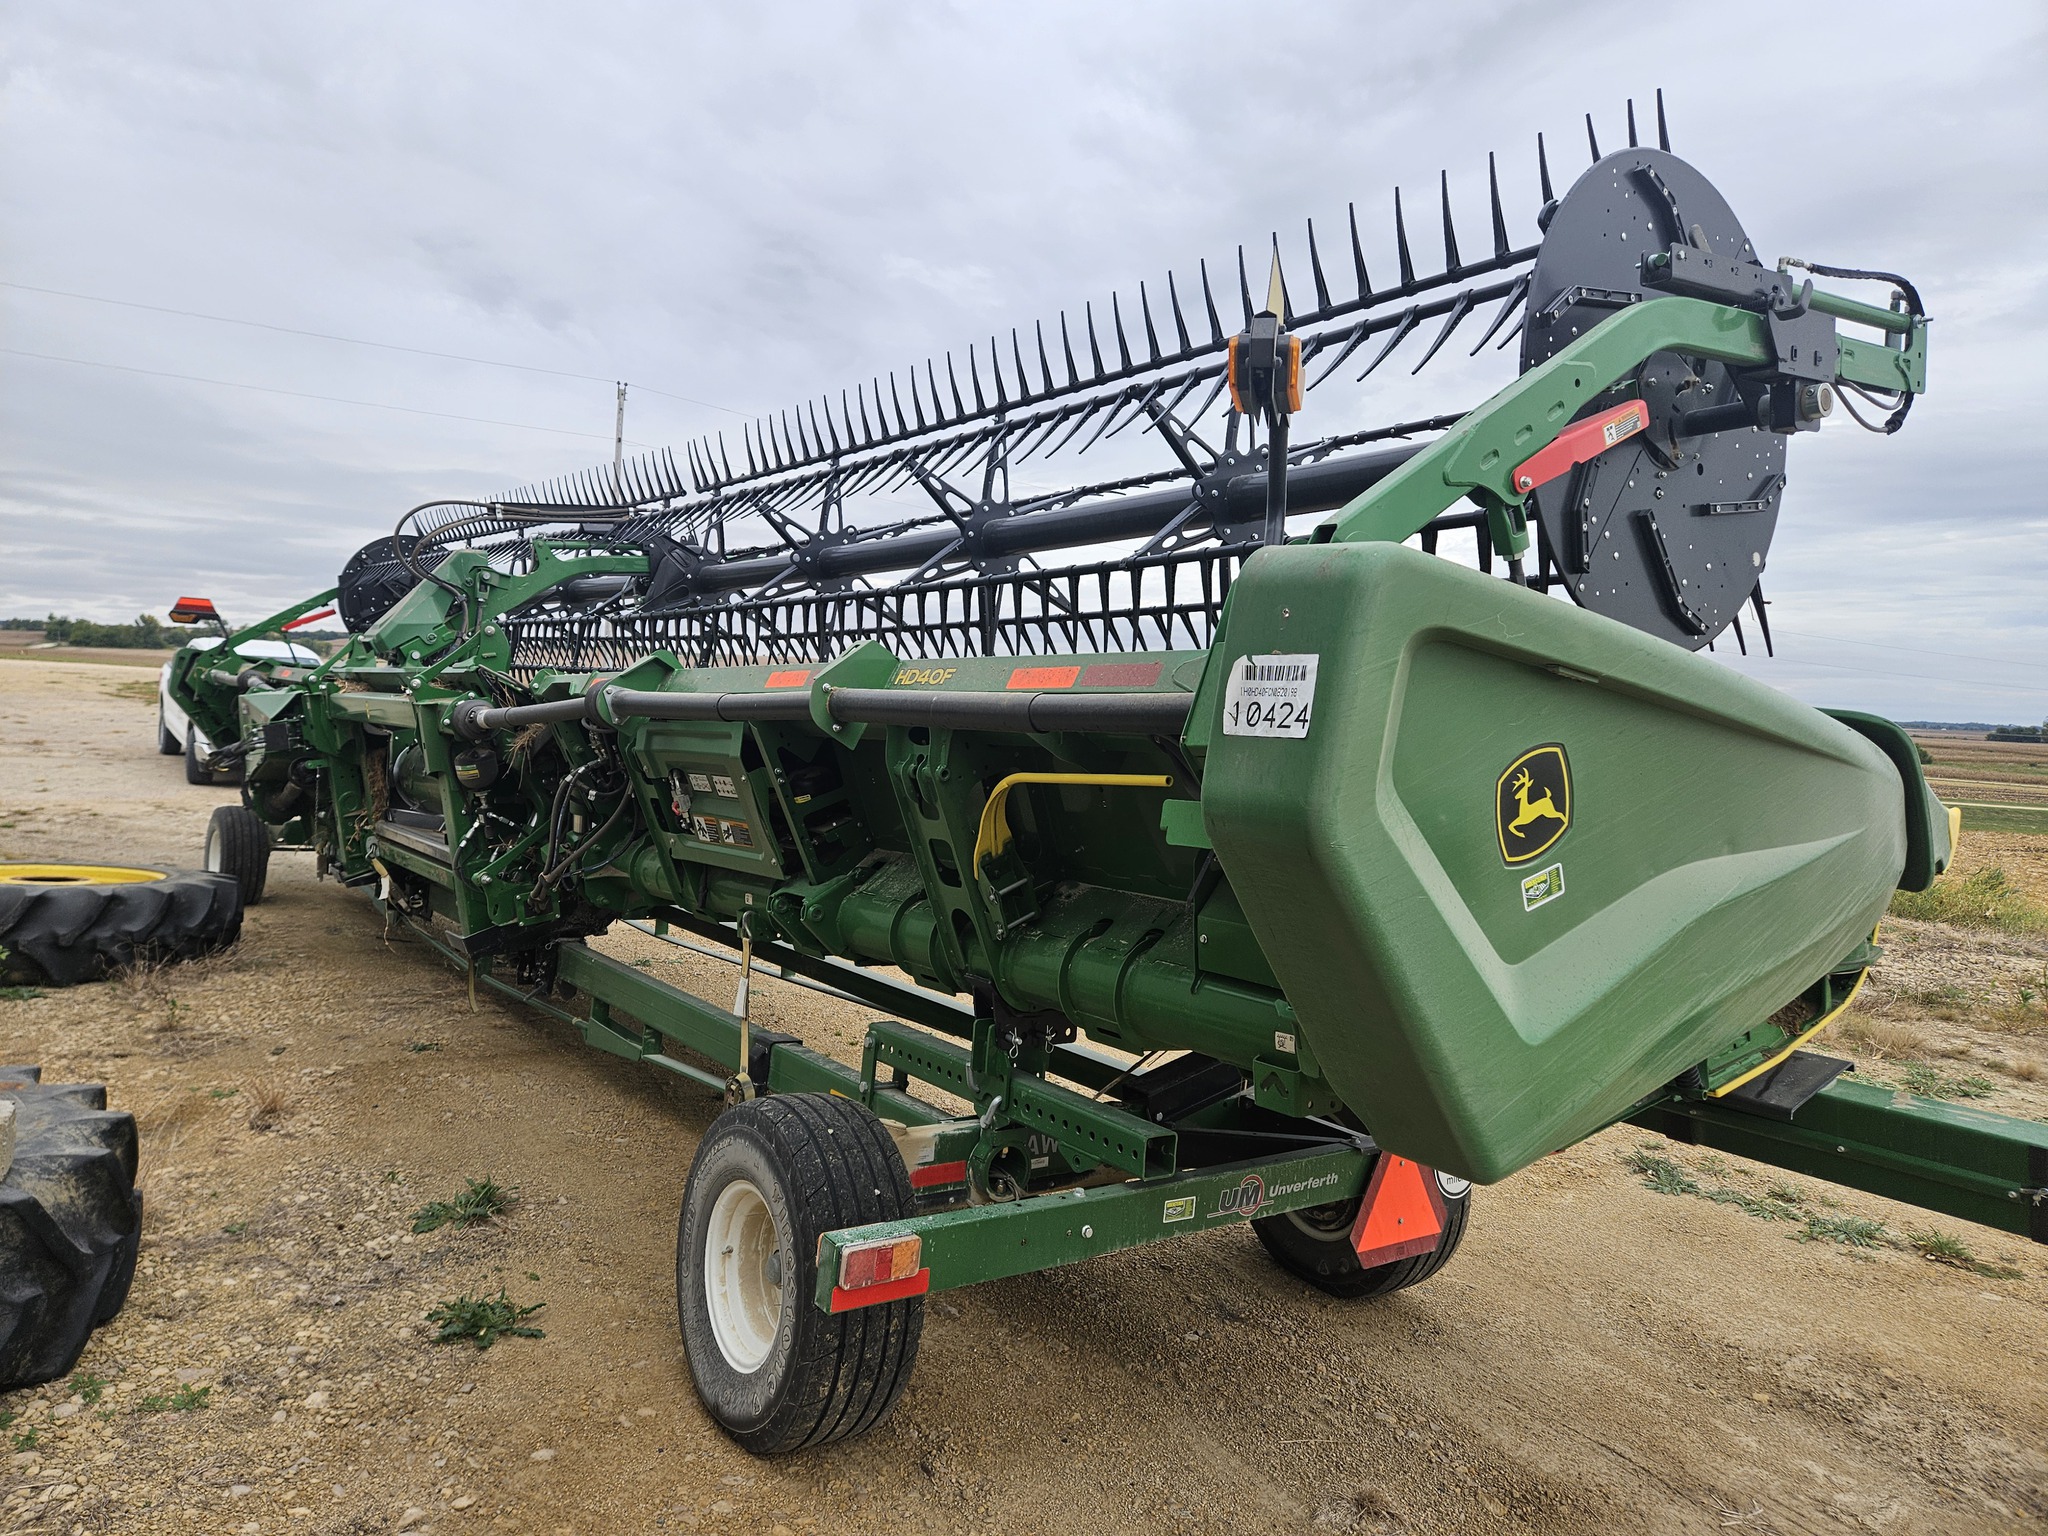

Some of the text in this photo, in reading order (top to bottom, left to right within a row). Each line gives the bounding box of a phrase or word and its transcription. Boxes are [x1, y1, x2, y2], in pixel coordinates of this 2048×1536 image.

[1708, 259, 1713, 269] 3
[1734, 266, 1740, 276] 2
[893, 667, 958, 686] HD40F
[1232, 700, 1309, 730] 10424
[1218, 1182, 1262, 1213] UM
[1269, 1172, 1339, 1197] Unverferth
